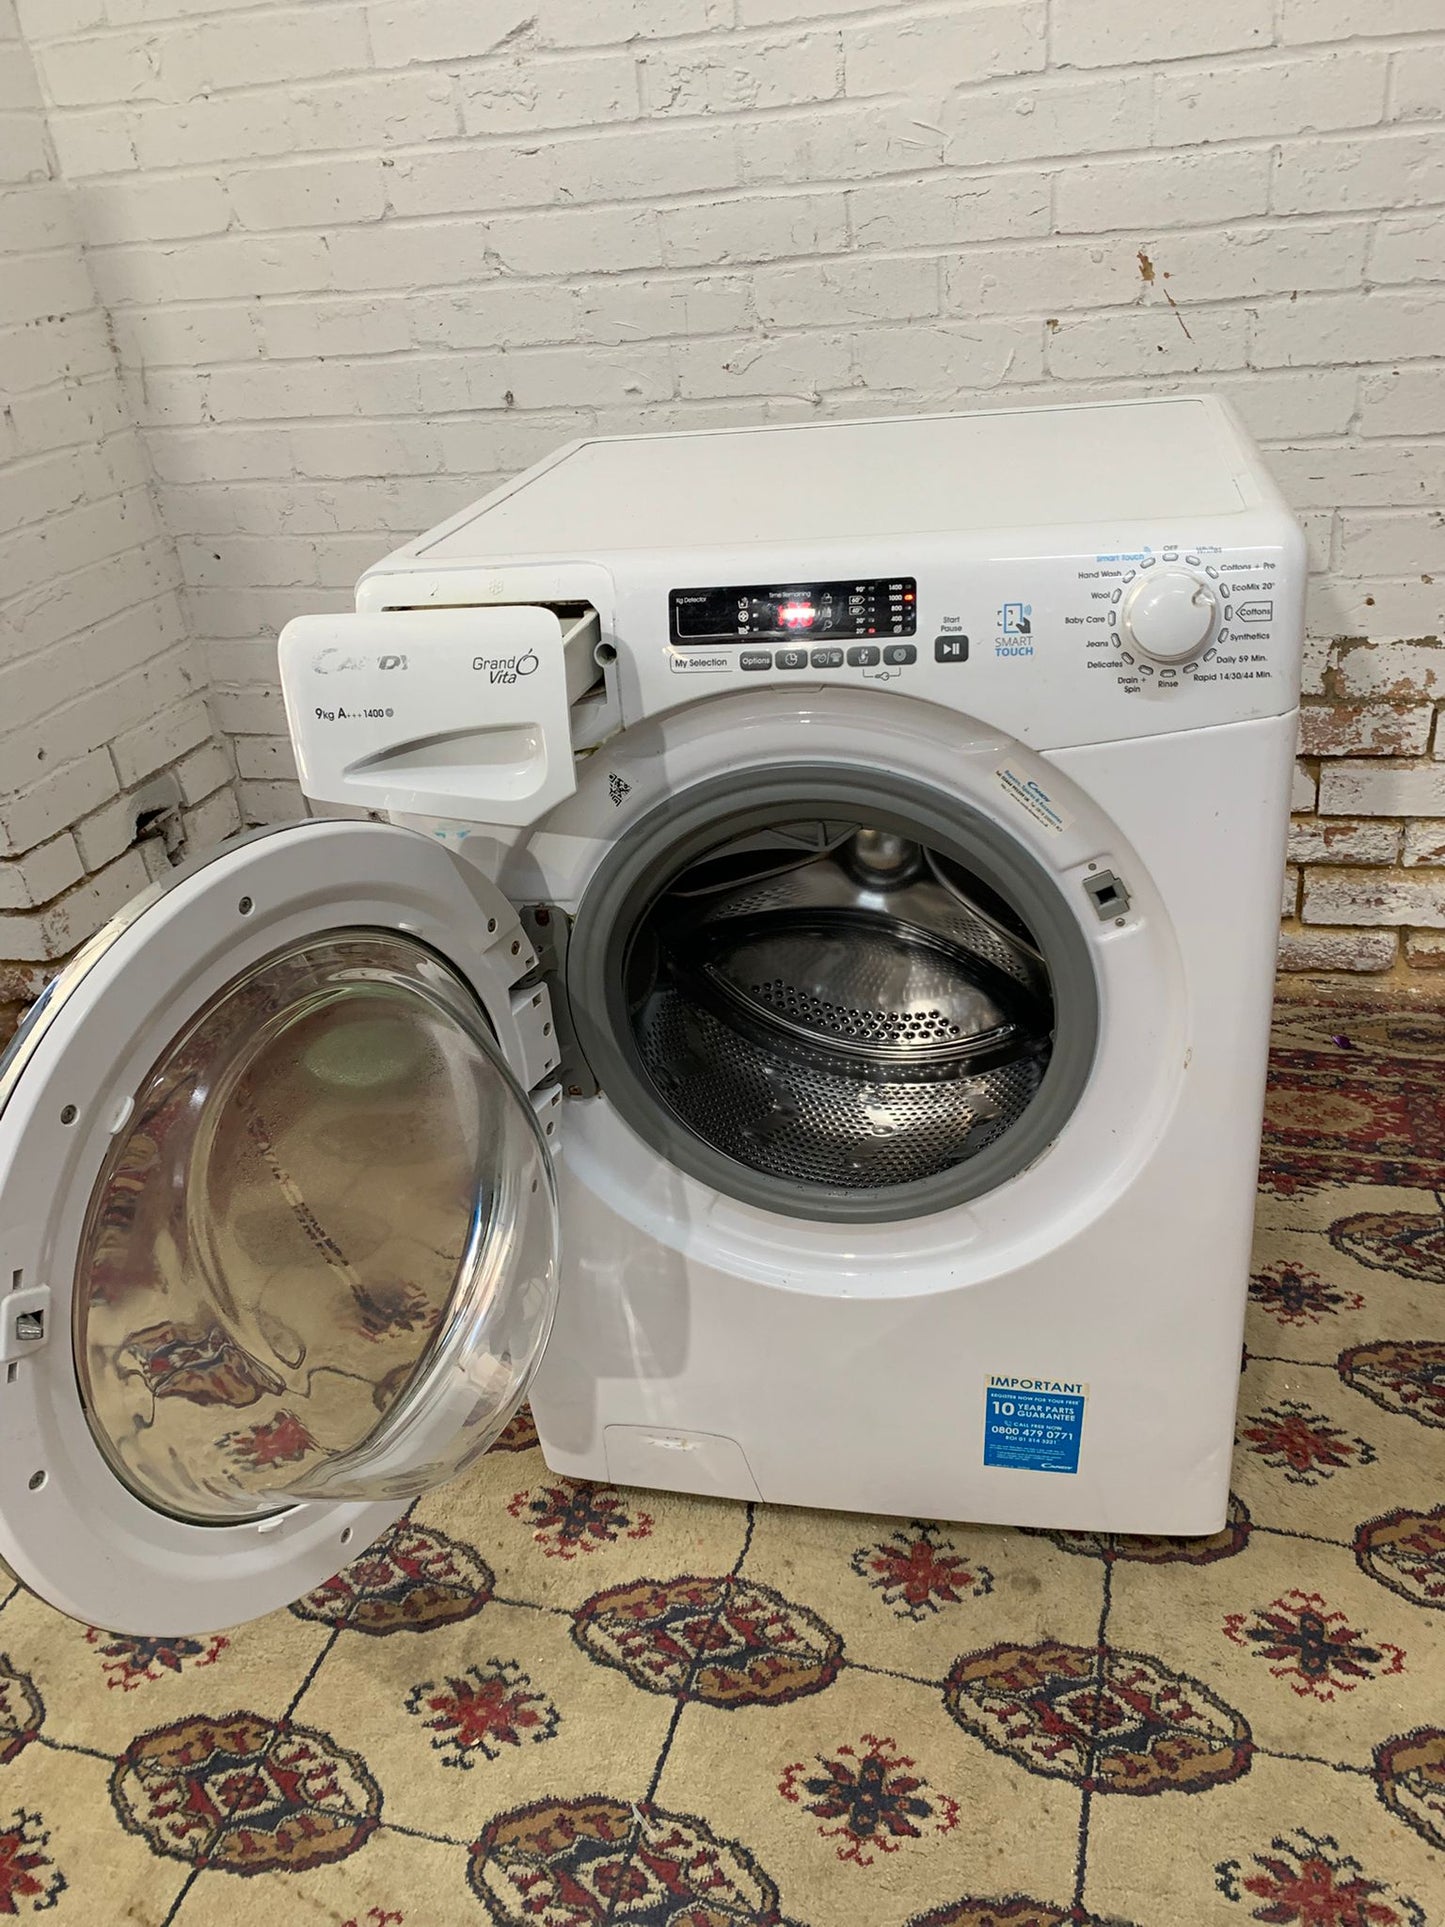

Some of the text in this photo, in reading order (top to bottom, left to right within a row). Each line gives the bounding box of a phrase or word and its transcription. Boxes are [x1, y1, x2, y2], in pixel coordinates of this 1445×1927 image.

[1220, 563, 1252, 571] Cottons
[1263, 562, 1276, 570] Pro
[1078, 570, 1122, 580] Hand Wash
[1231, 583, 1261, 592] EcoMix
[684, 596, 707, 604] Detector
[1091, 591, 1111, 600] Wool
[1240, 608, 1271, 617] Cottons
[1065, 615, 1106, 625] Baby Care
[940, 624, 963, 632] Pause
[1229, 631, 1270, 641] Synthetics
[994, 636, 1034, 648] SMART
[1086, 639, 1109, 649] Jeans
[994, 647, 1034, 657] TOUCH
[472, 656, 516, 671] Grand
[675, 657, 728, 668] My Selection
[742, 656, 771, 666] Options
[1216, 654, 1268, 664] Daily 59 Min.
[1087, 660, 1123, 669] Delicates
[489, 670, 517, 684] Vita
[1117, 676, 1138, 685] Drain
[1193, 670, 1273, 682] Rapid 14/30/44 Min.
[1158, 680, 1179, 688] Rinse
[1123, 685, 1141, 694] Spin
[315, 707, 335, 721] 9kg
[363, 709, 385, 718] 1400
[991, 1376, 1083, 1394] IMPORTANT
[992, 1401, 1075, 1416] 10 YEAR PARTS
[1017, 1410, 1076, 1422] GUARANTEE
[1013, 1420, 1029, 1428] CALL
[991, 1425, 1073, 1441] 0800 479 0771
